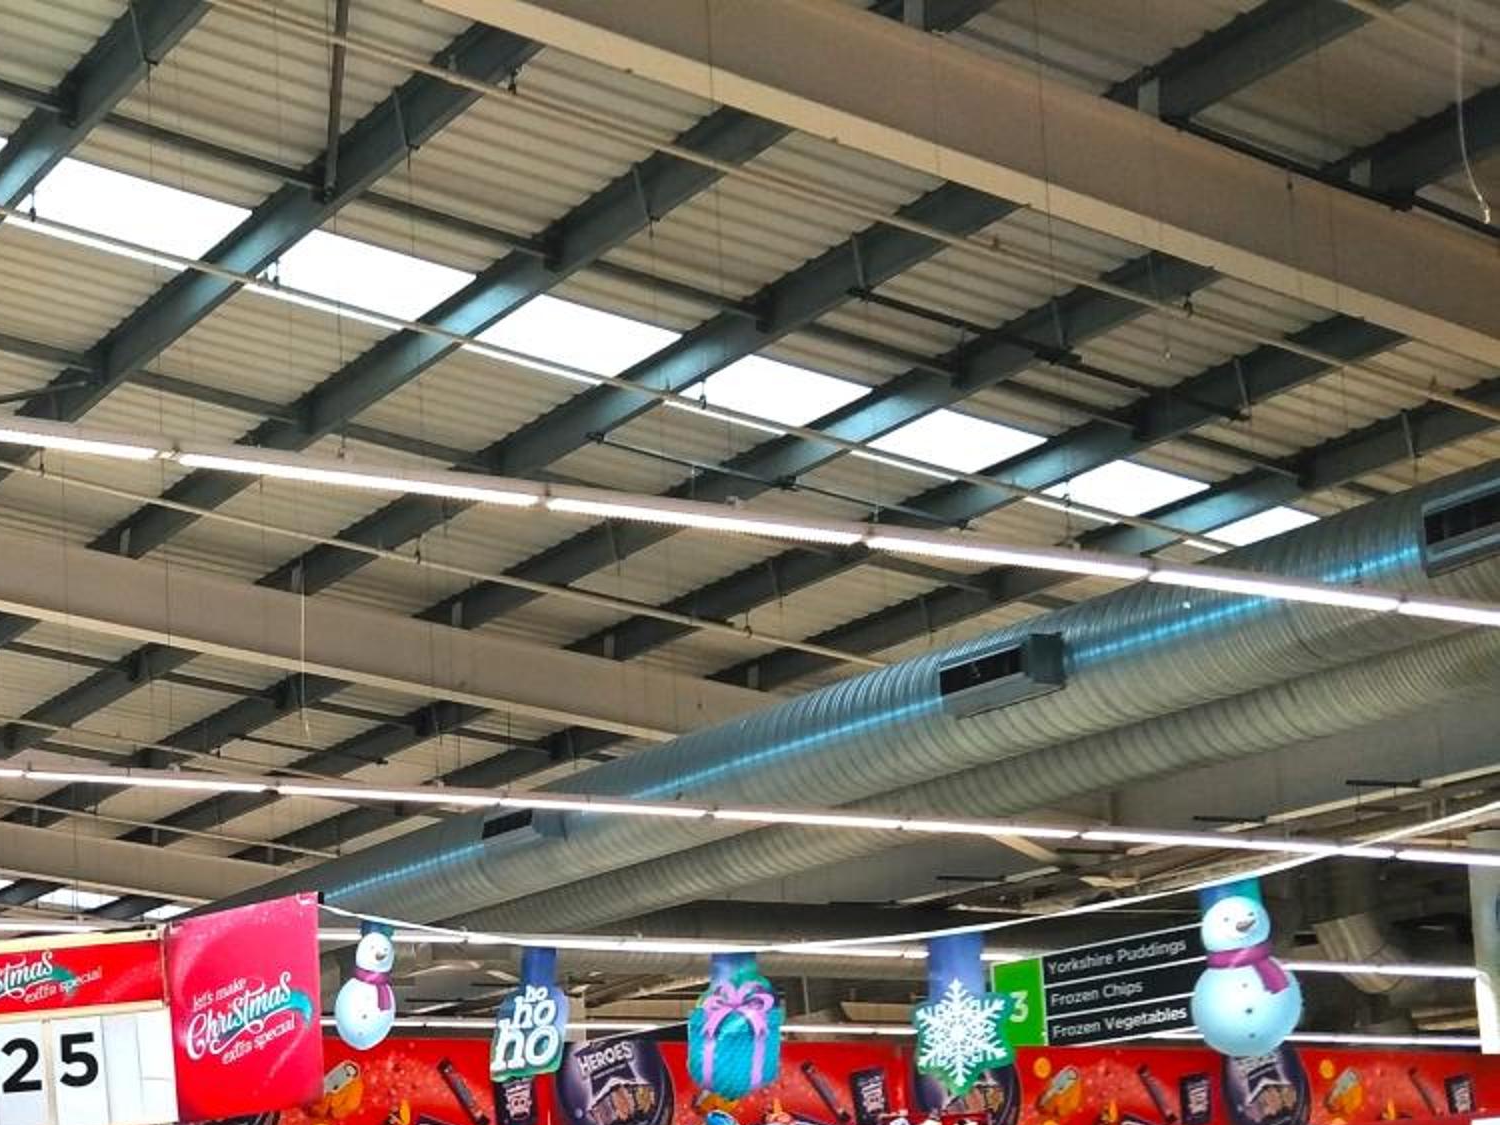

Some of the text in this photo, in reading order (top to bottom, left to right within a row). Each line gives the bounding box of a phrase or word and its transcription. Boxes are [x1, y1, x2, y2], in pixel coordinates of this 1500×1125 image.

[1047, 939, 1187, 975] Yorkshire Puddings
[525, 985, 549, 1002] ho
[1009, 989, 1030, 1023] 3
[1050, 980, 1144, 1007] Frozen Chips
[185, 971, 292, 1061] Christmas
[512, 995, 557, 1030] ho
[1052, 1006, 1188, 1038] Frozen Vegetables
[489, 1017, 560, 1071] ho
[577, 1041, 634, 1076] HEROES
